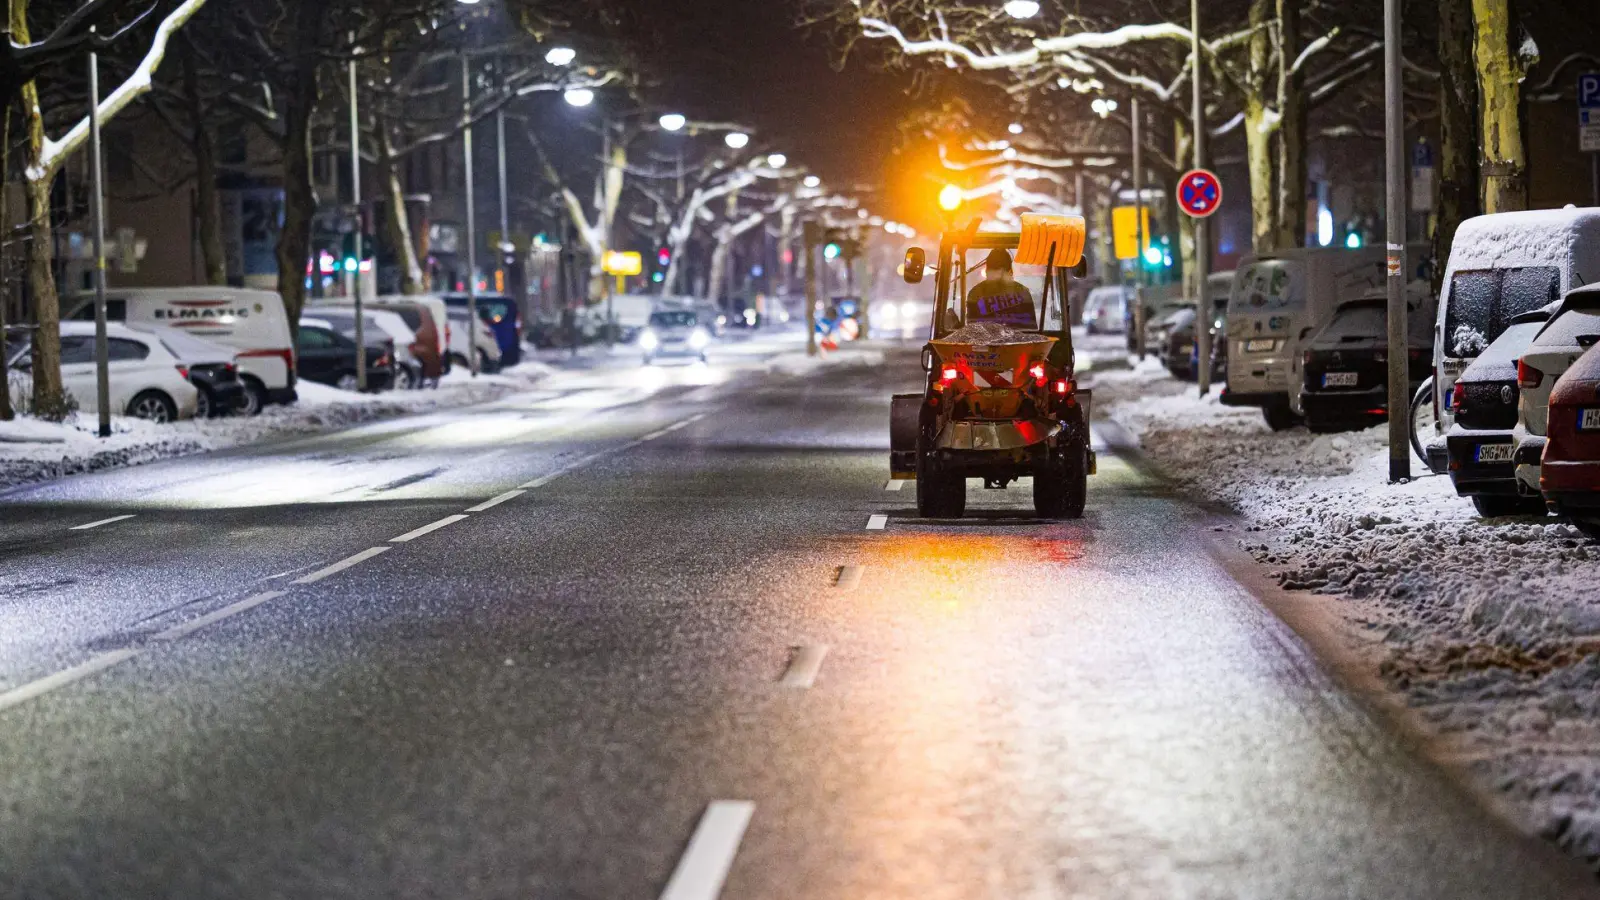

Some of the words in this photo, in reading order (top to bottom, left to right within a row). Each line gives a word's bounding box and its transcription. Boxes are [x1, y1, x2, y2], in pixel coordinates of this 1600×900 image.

[1583, 78, 1598, 103] P
[155, 308, 248, 319] ELMATIC
[1480, 446, 1494, 460] SHG
[1500, 445, 1510, 459] MK
